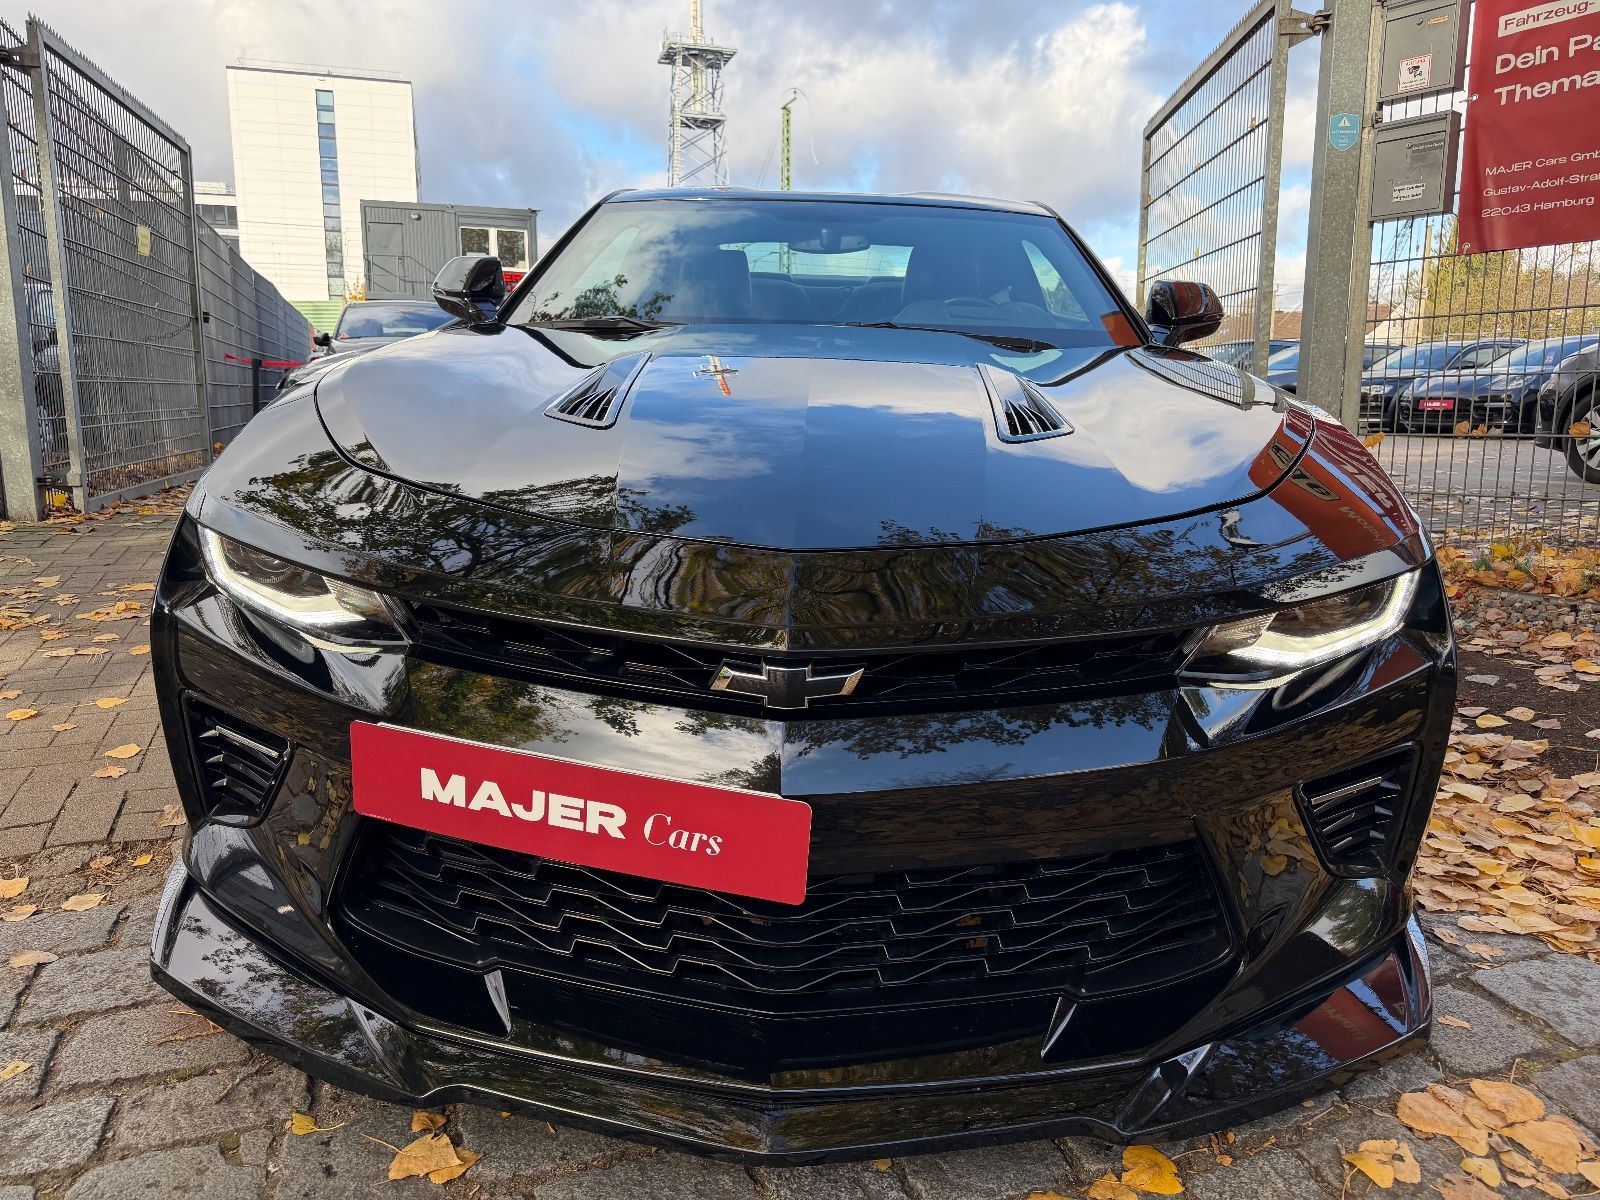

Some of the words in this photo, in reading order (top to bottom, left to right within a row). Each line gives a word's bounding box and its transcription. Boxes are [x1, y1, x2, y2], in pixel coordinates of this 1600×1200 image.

[1504, 1, 1595, 31] Fahrzeug-
[1495, 46, 1559, 74] Dein
[1493, 70, 1600, 105] Thema
[1485, 161, 1532, 176] MAJER
[1535, 156, 1567, 168] Cars
[1483, 173, 1600, 197] Gustav-Adolf-Stra
[1481, 204, 1531, 218] 22043
[1534, 196, 1595, 211] Hamburg
[420, 767, 627, 840] MAJER
[643, 813, 723, 856] Cars
